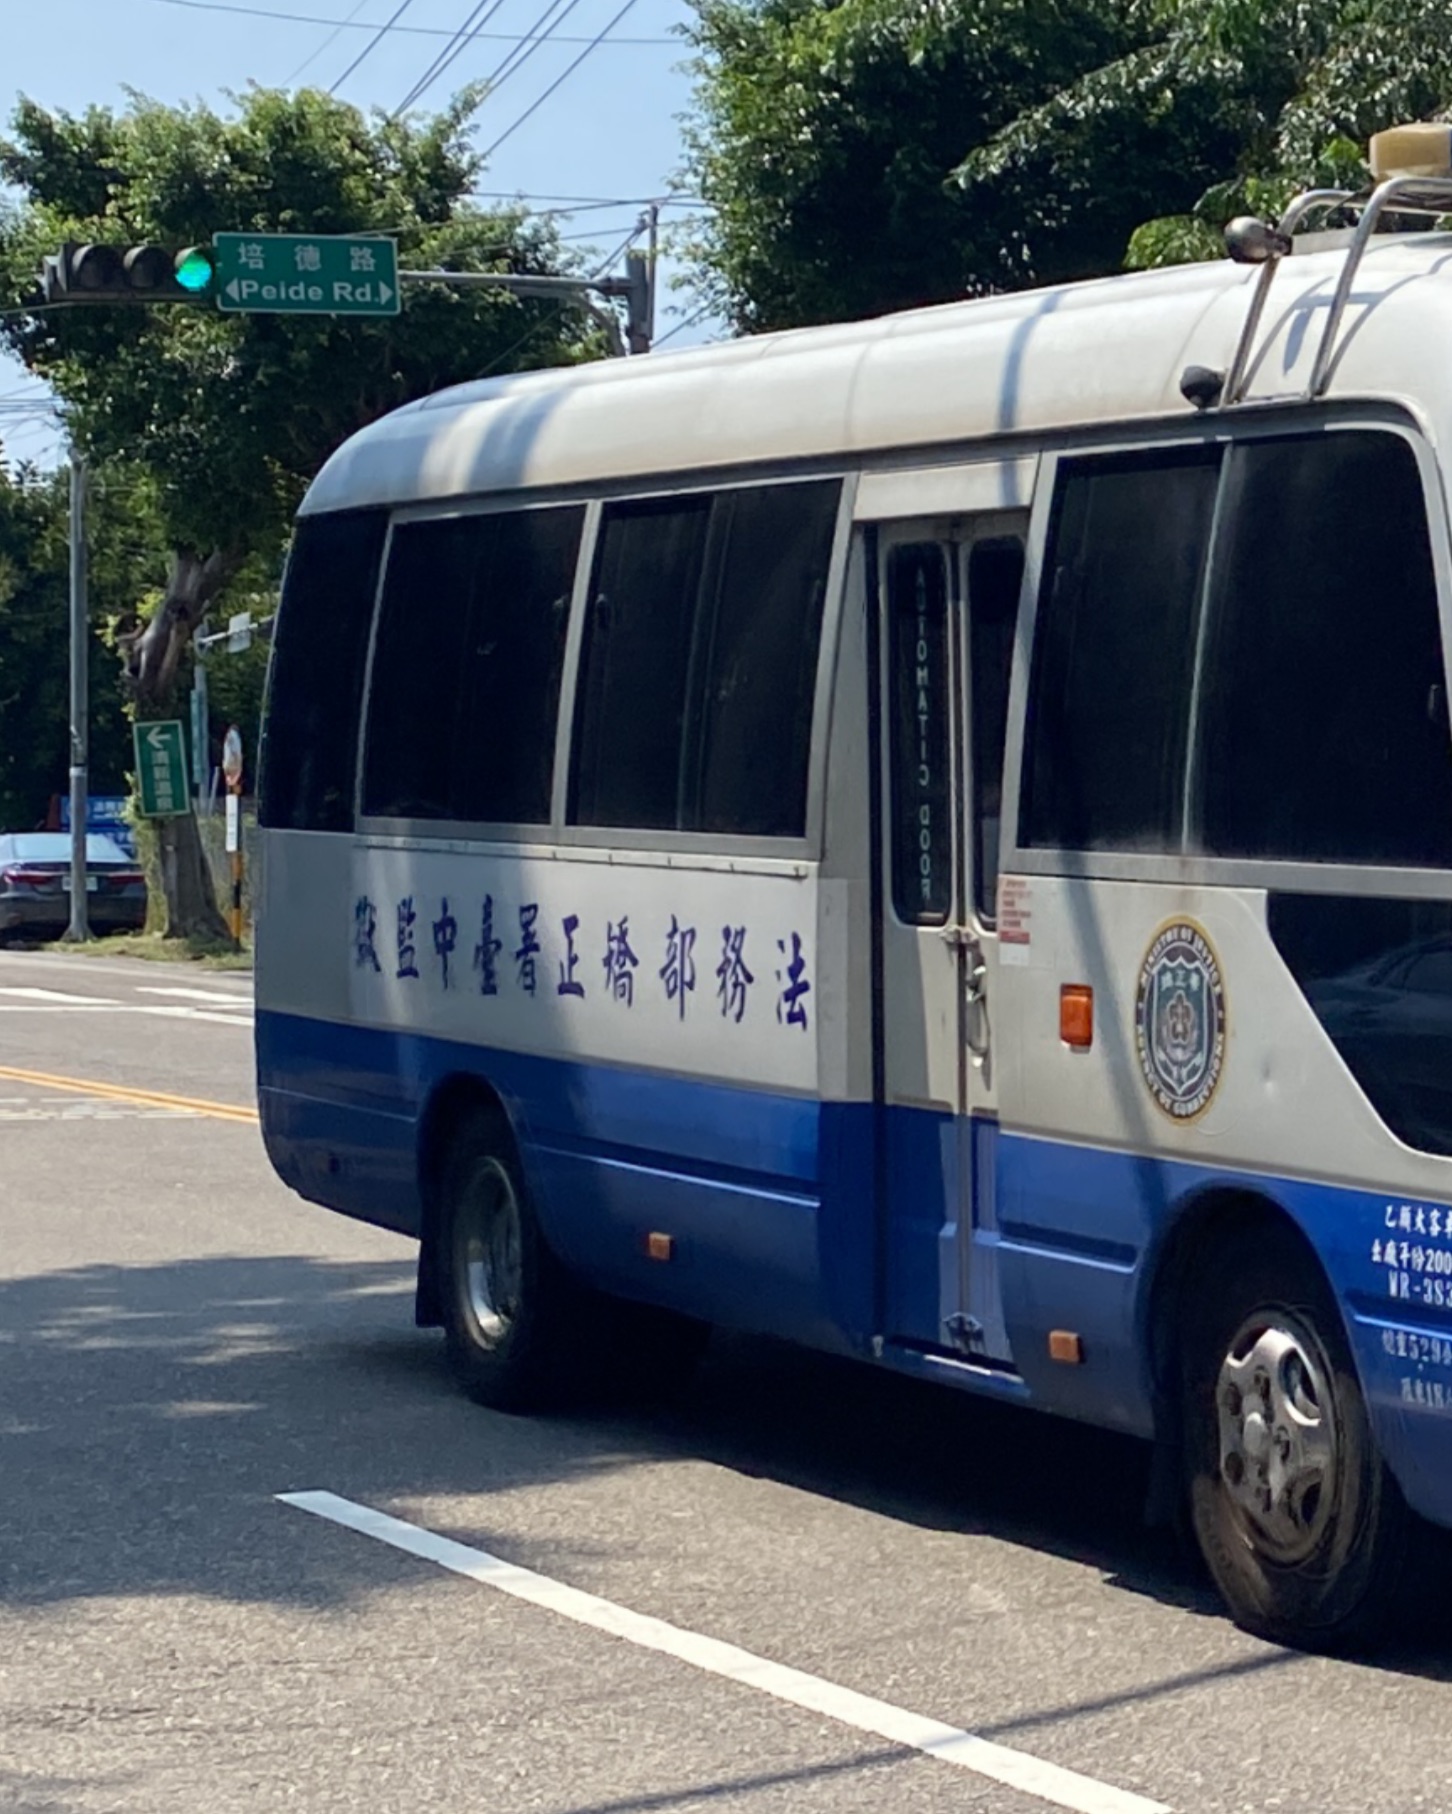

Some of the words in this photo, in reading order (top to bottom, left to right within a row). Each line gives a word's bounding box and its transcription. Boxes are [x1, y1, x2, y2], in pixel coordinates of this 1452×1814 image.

[238, 242, 376, 271] 培德路
[241, 279, 323, 301] Peide
[333, 281, 380, 302] Rd.
